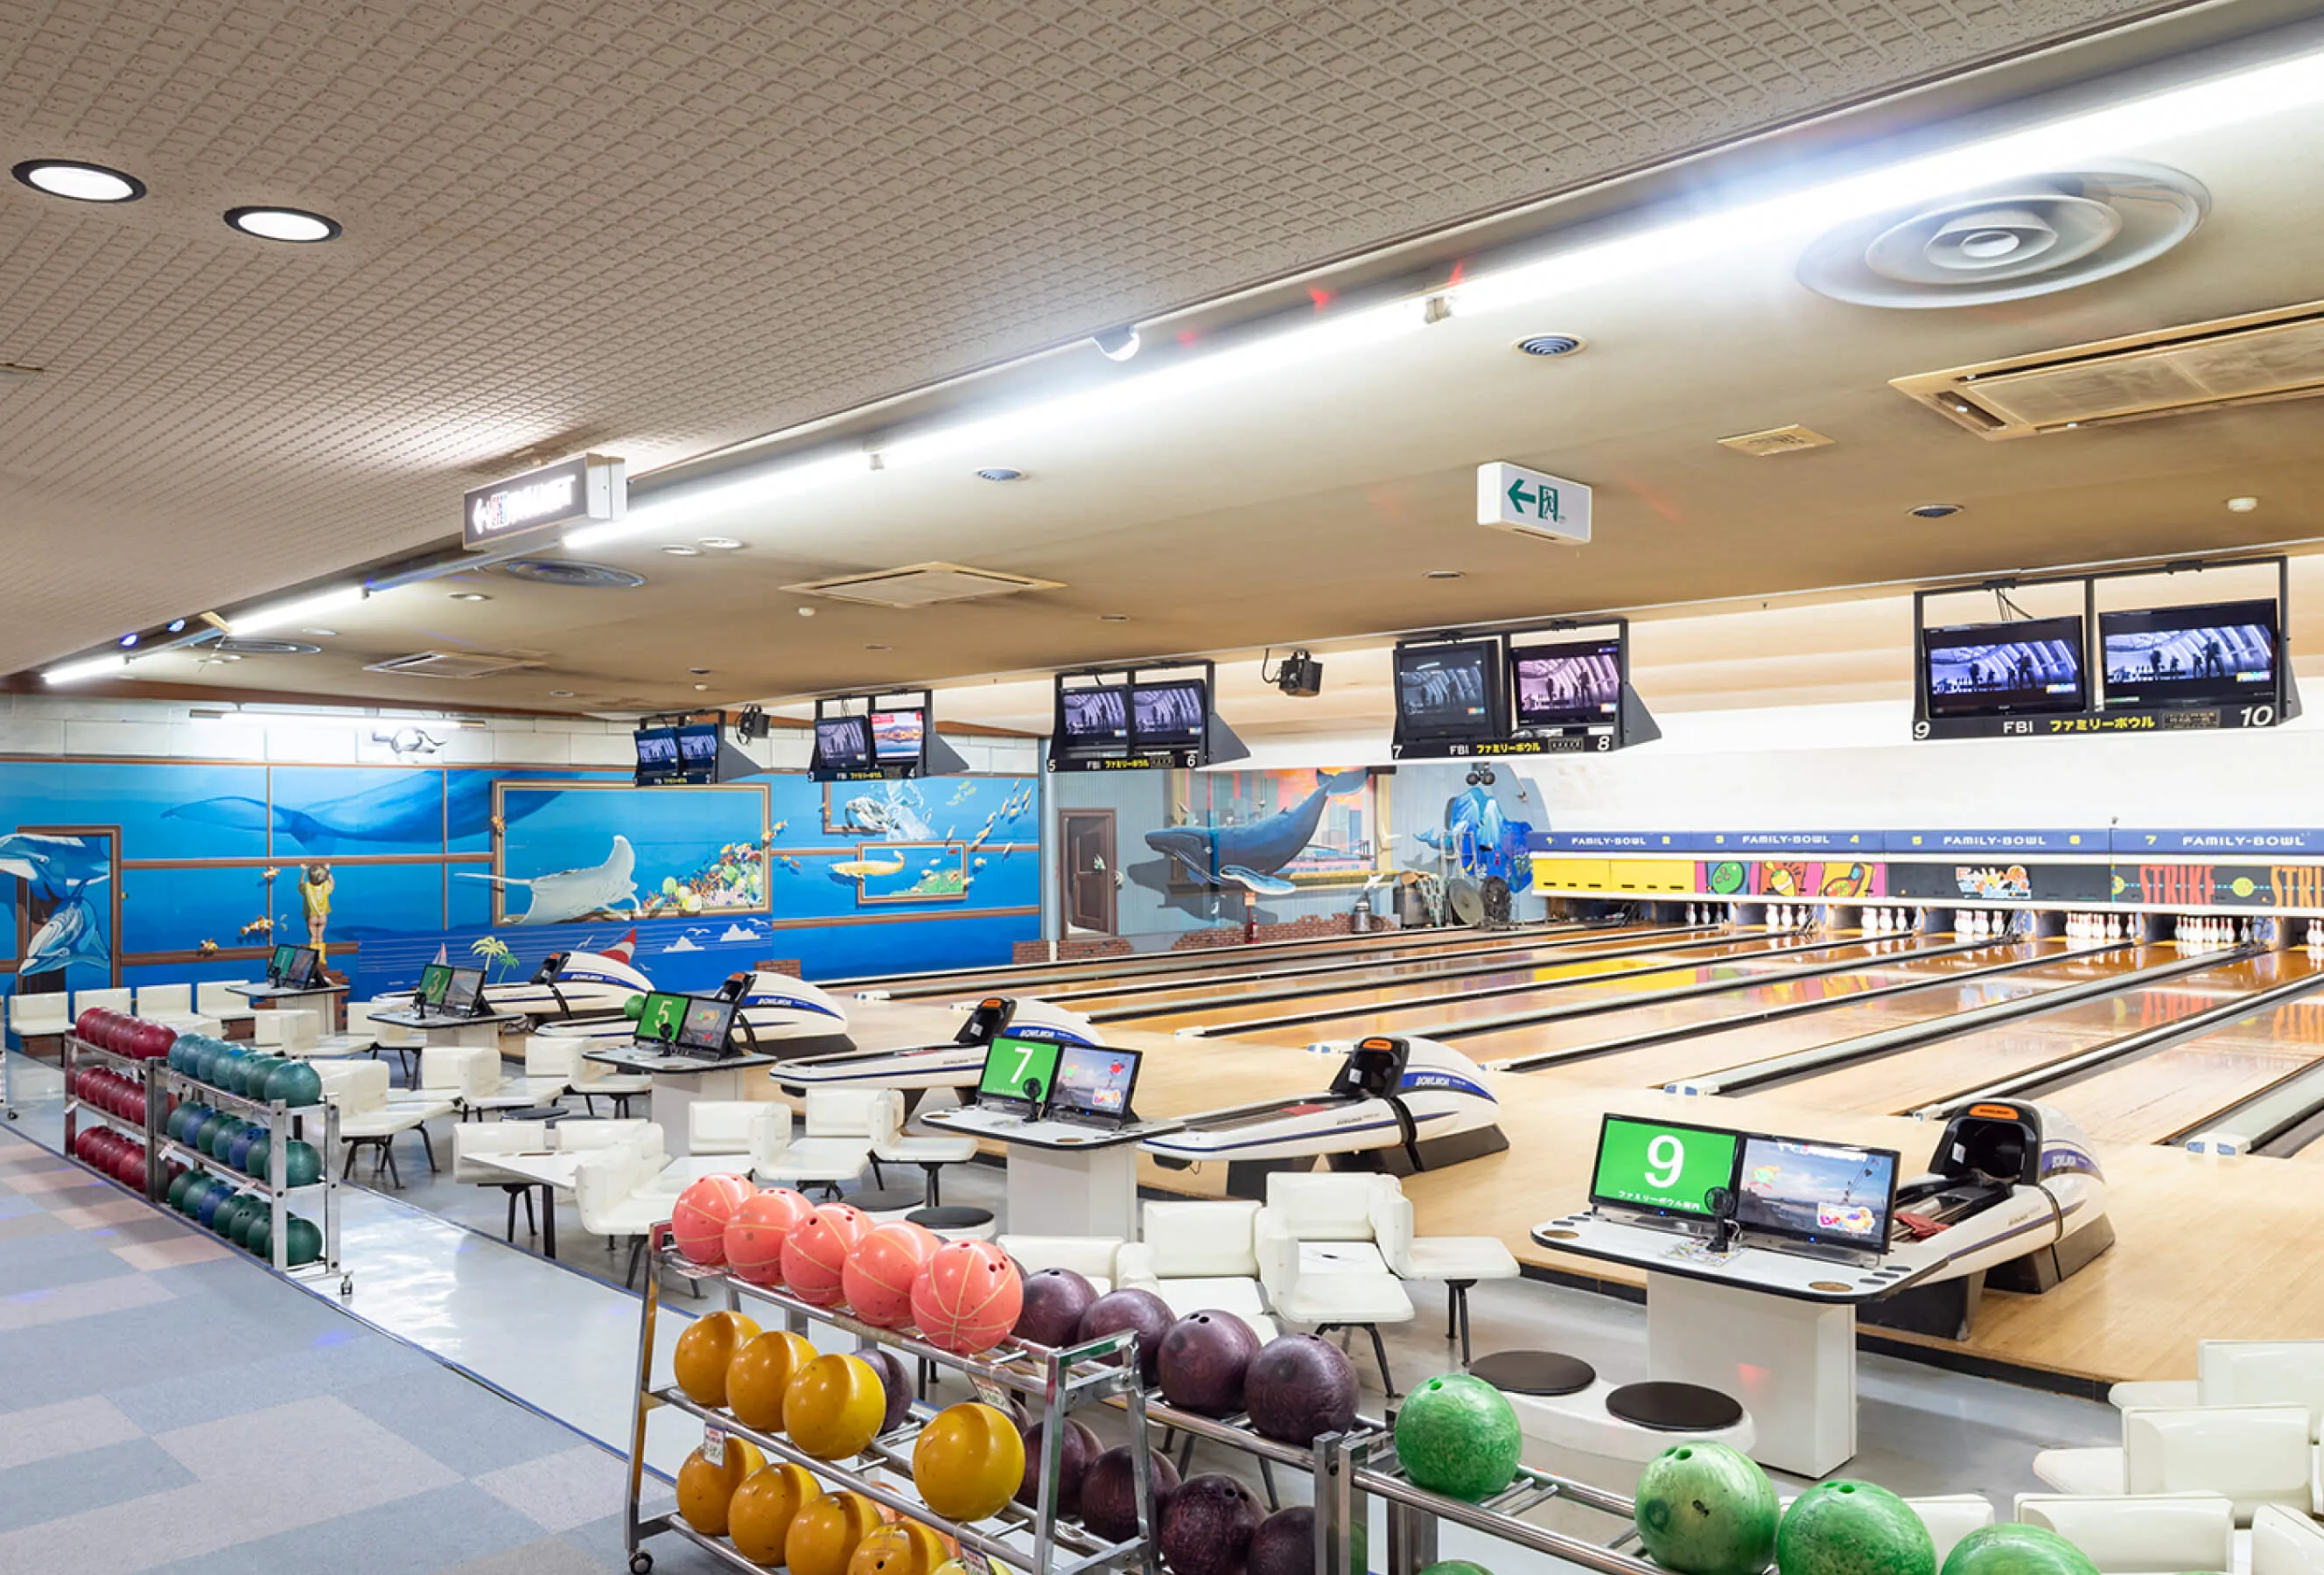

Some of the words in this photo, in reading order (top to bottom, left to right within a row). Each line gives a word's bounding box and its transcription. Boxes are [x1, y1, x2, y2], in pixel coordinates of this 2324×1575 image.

[1914, 720, 1931, 739] 9
[2003, 720, 2034, 734] FBI
[2049, 716, 2155, 732] ファミリーボウル
[2240, 705, 2274, 727] 10
[1392, 744, 1403, 759] 7
[1449, 744, 1470, 755] FBI
[1597, 735, 1610, 752] 8
[1572, 836, 1647, 846] FAMILY-BOWL
[1742, 835, 1830, 844] FAMILY-BOWL
[1850, 834, 1859, 844] 4
[1942, 836, 2047, 846] FAMILY-BOWL
[2145, 836, 2158, 845] 7
[2182, 836, 2305, 846] FAMILY-BOWL
[2139, 865, 2216, 906] STRIKE
[428, 970, 442, 995] 3
[654, 1000, 673, 1030] 5
[1010, 1046, 1034, 1084] 7
[1644, 1135, 1684, 1188] 9
